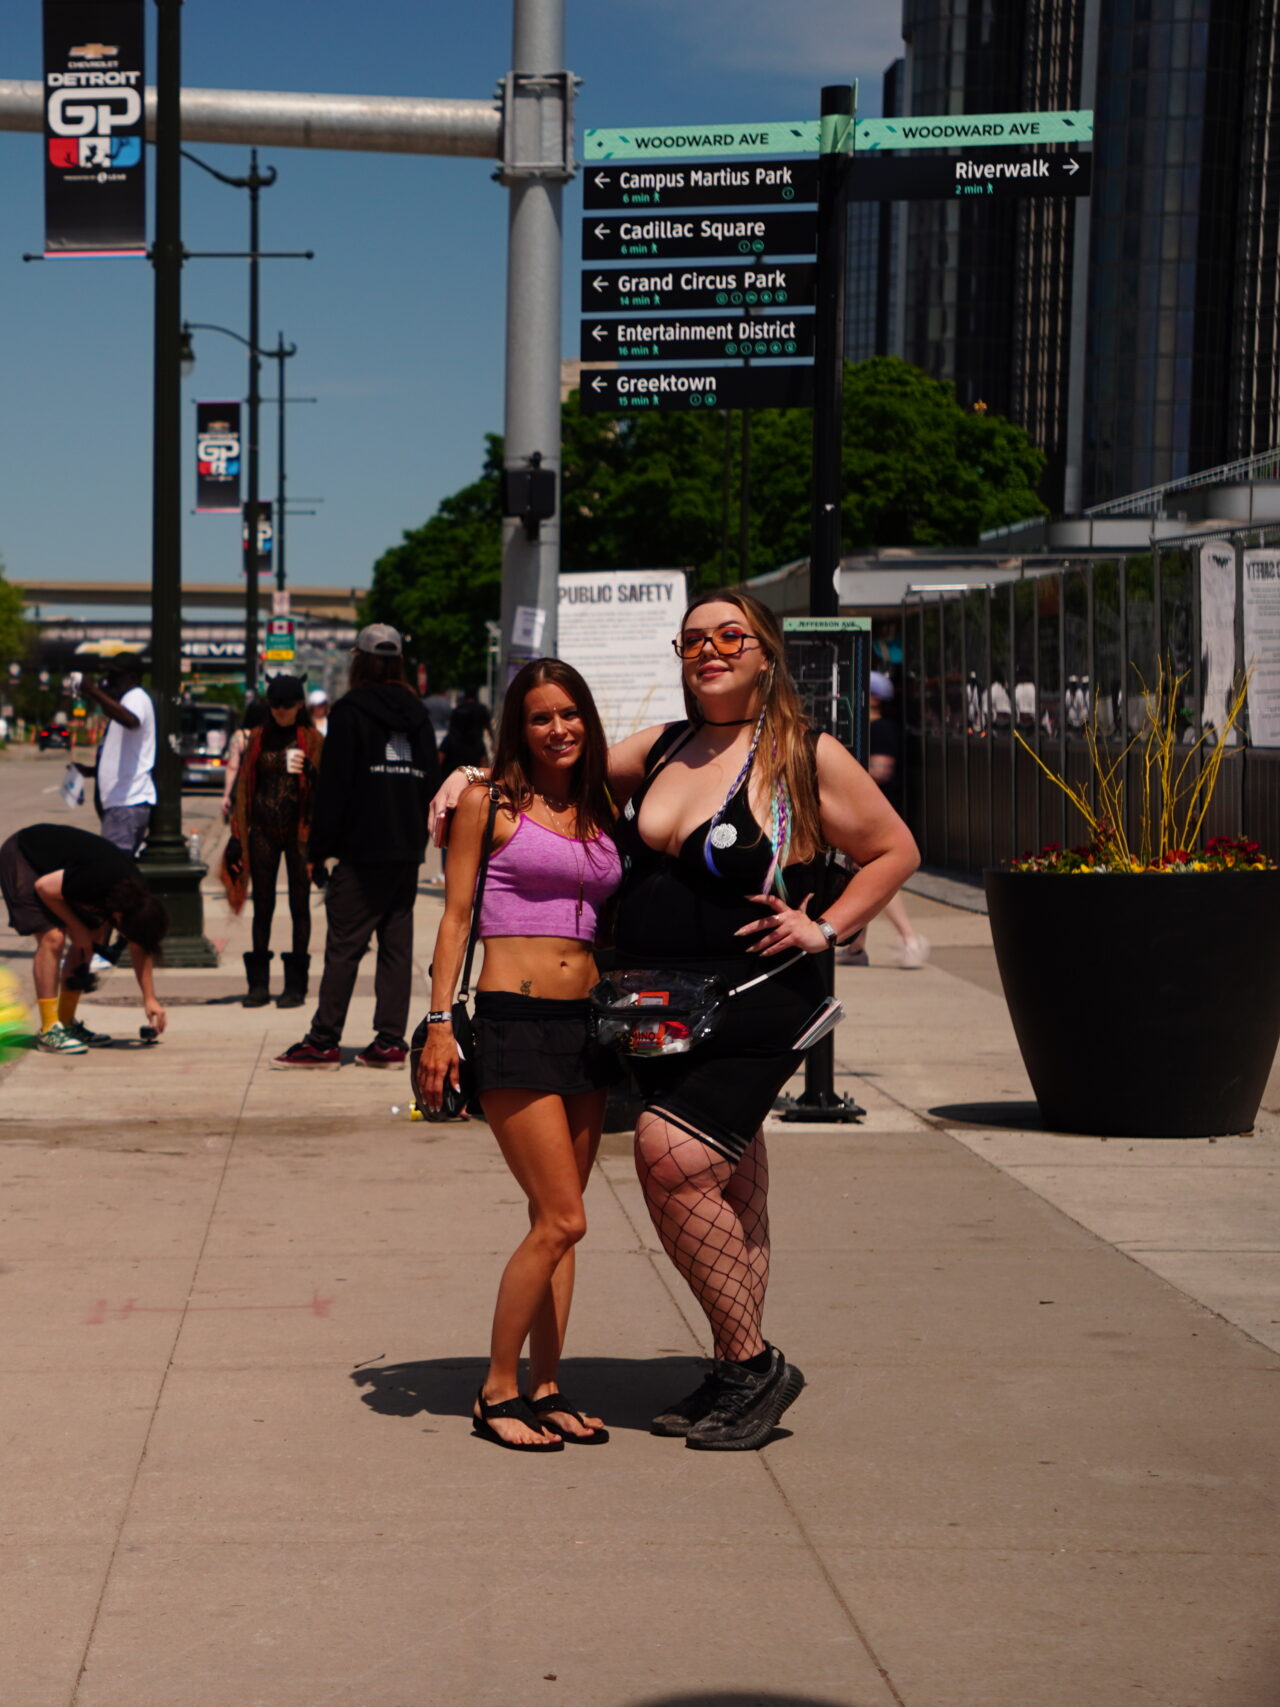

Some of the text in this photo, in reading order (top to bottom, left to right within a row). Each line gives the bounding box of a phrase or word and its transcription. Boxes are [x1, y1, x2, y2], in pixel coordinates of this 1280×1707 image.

[47, 71, 141, 87] DETROIT
[48, 87, 141, 136] GP
[902, 122, 1040, 139] WOODWARD AVE
[635, 133, 769, 149] WOODWARD AVE
[955, 159, 1049, 179] Riverwalk
[620, 166, 792, 192] Campus Martius Park
[623, 192, 650, 204] 6 min
[955, 183, 983, 195] 2 min
[620, 220, 765, 241] Cadillac Square
[621, 243, 648, 255] 6 min
[618, 270, 786, 292] Grand Circus Park
[632, 295, 650, 305] min
[617, 321, 796, 342] Entertainment District
[631, 345, 649, 356] min
[617, 374, 717, 393] Greektown
[631, 395, 649, 406] min
[198, 440, 241, 462] GP
[558, 583, 674, 604] PUBLIC SAFETY
